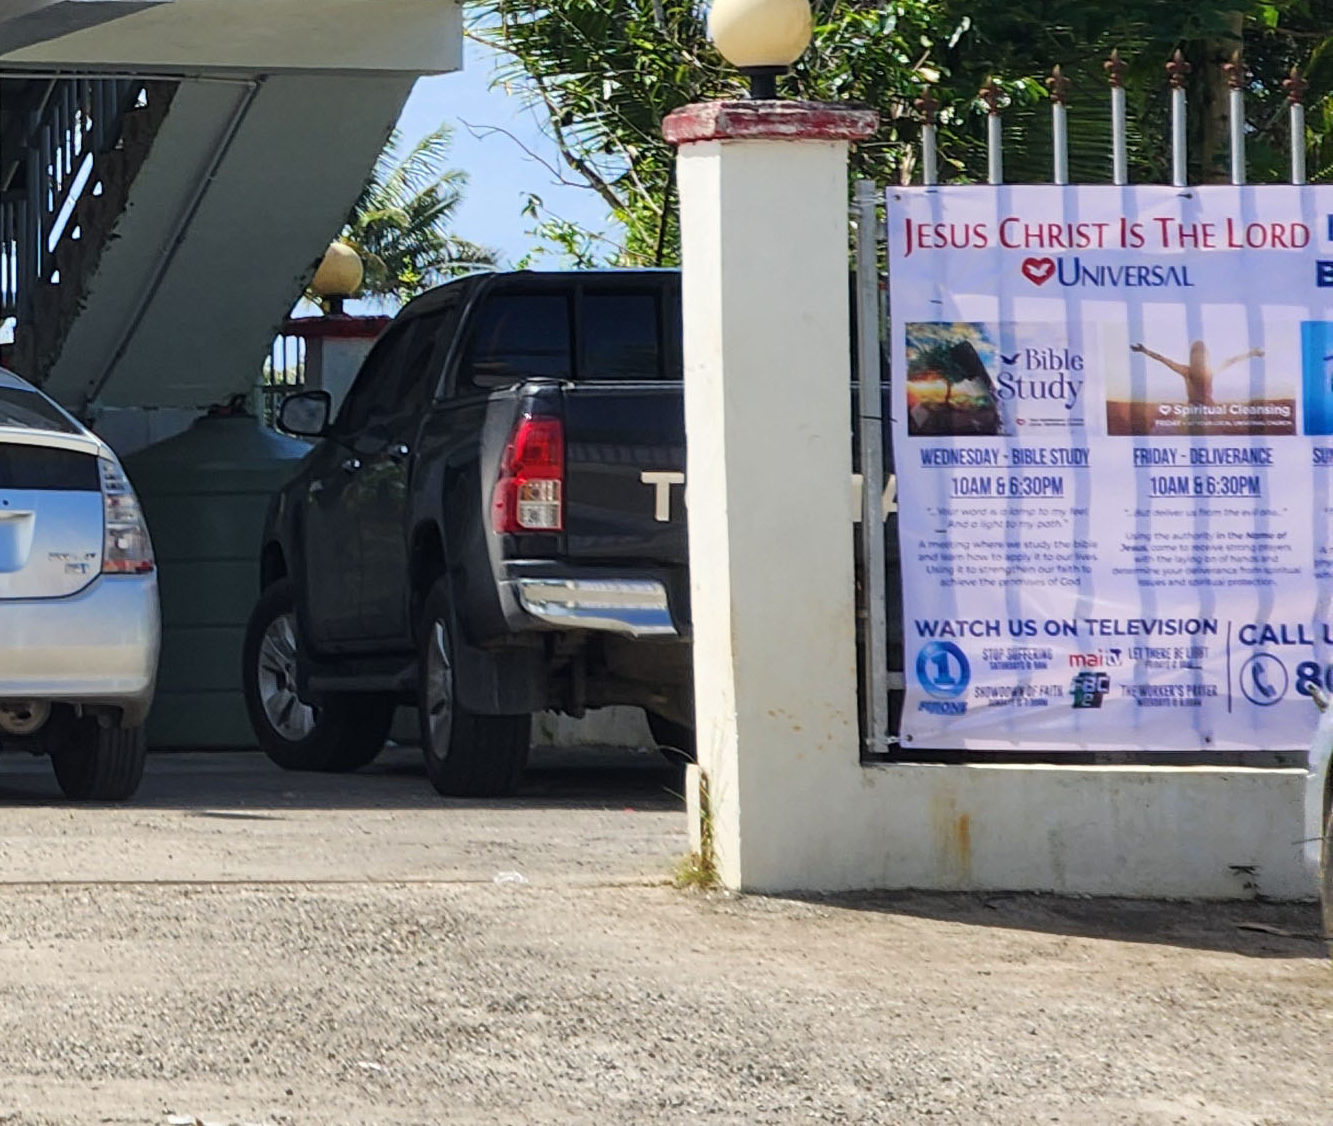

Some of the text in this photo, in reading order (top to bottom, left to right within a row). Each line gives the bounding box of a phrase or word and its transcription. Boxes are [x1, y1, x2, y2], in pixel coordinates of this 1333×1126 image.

[904, 217, 988, 258] JESUS
[998, 217, 1110, 249] CHRIST
[1120, 218, 1145, 249] IS
[1152, 217, 1216, 249] THE
[1226, 217, 1311, 249] LORD
[1056, 257, 1195, 287] UNIVERSAL
[1025, 348, 1084, 371] Bible
[996, 371, 1083, 410] Study
[1173, 404, 1291, 418] Spiritual Cleansing
[920, 447, 999, 465] WEDNESDAY
[1012, 447, 1047, 465] BIBLE
[1050, 447, 1090, 465] STUDY
[1133, 447, 1177, 465] FRIDAY
[1189, 447, 1274, 465] DELIVERANCE
[951, 476, 1064, 495] 10AM & 6:30PM
[1150, 476, 1261, 495] 10AM & 6:30PM
[914, 618, 1218, 638] WATCH US ON TELEVISION
[1238, 623, 1315, 646] CALL
